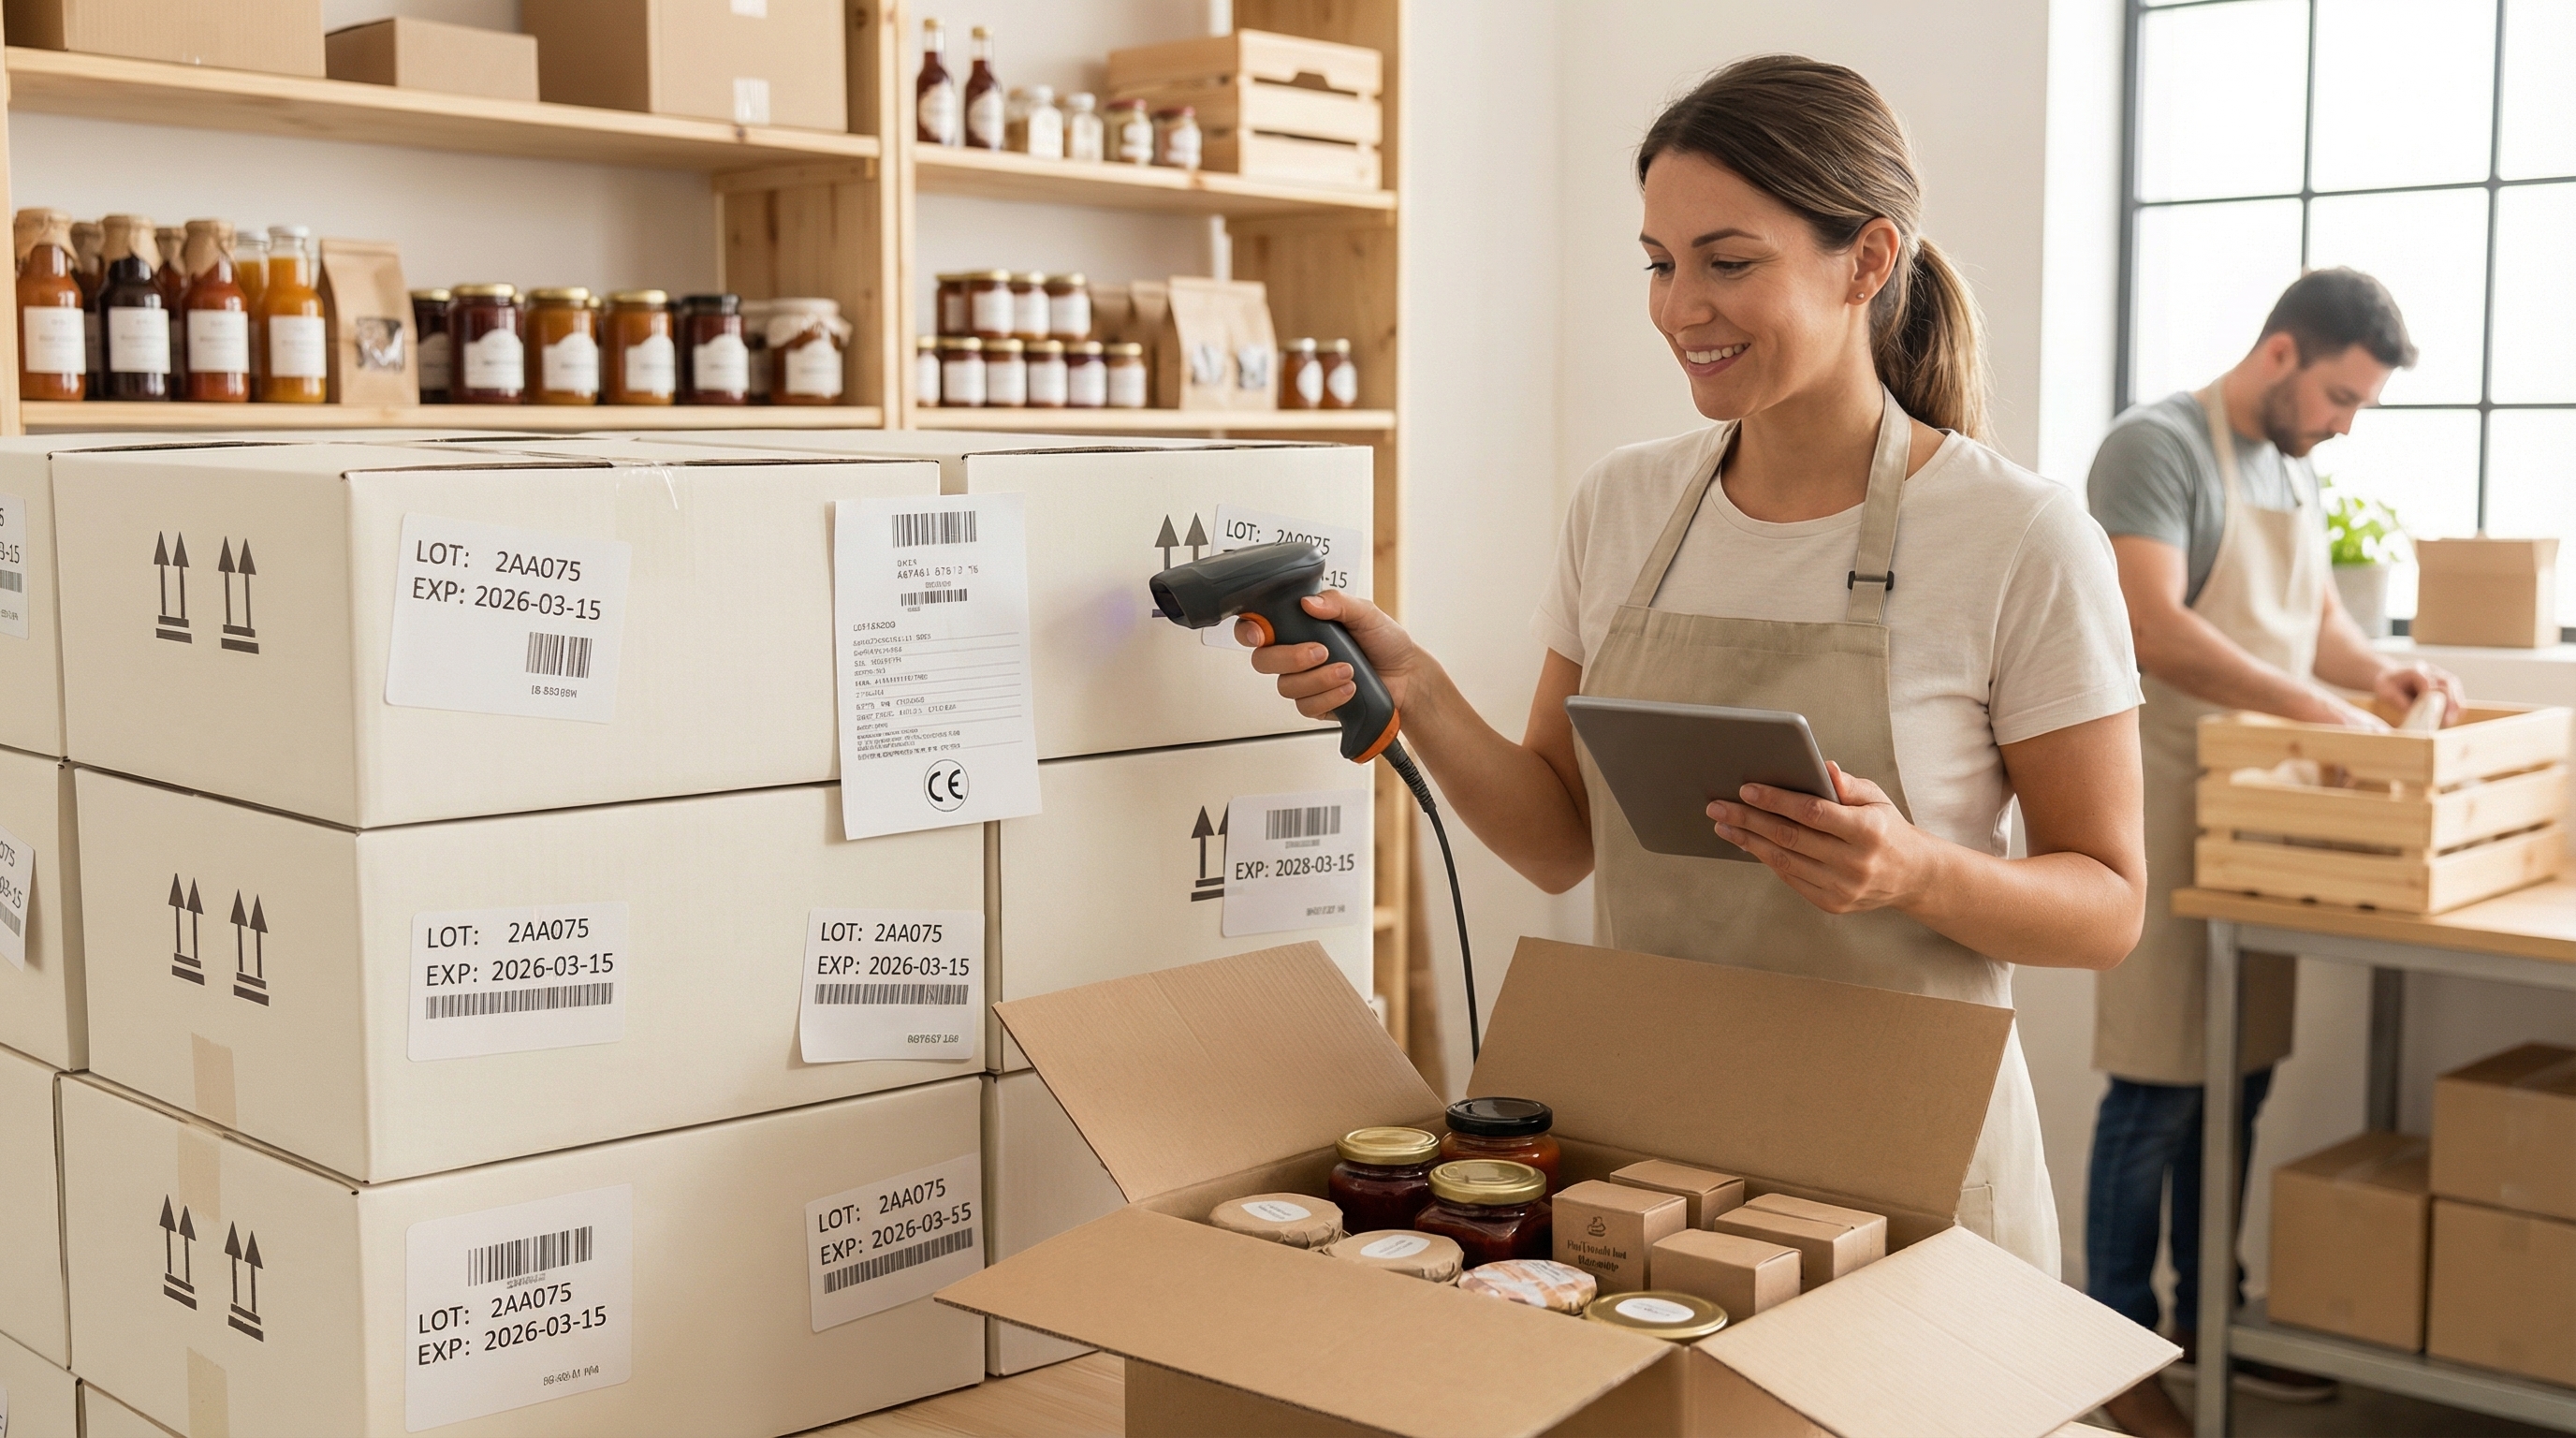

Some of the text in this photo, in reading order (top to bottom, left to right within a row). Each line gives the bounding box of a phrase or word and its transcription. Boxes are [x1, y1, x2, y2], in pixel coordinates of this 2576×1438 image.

[1226, 519, 1261, 543] LOT:
[417, 540, 580, 581] LOT: 2AA075
[413, 578, 600, 620] EXP: 2026-03-15
[1237, 854, 1354, 880] EXP: 2028-03-15
[428, 918, 588, 948] LOT: 2AA075
[822, 922, 942, 943] LOT: 2AA075
[427, 953, 614, 986] EXP: 2026-03-15
[818, 956, 969, 976] EXP: 2026-03-15
[819, 1178, 945, 1233] LOT: 2AA075
[821, 1202, 972, 1266] EXP: 2026-03-55
[419, 1282, 572, 1333] LOT: 2AA075
[419, 1305, 607, 1365] EXP: 2026-03-15
